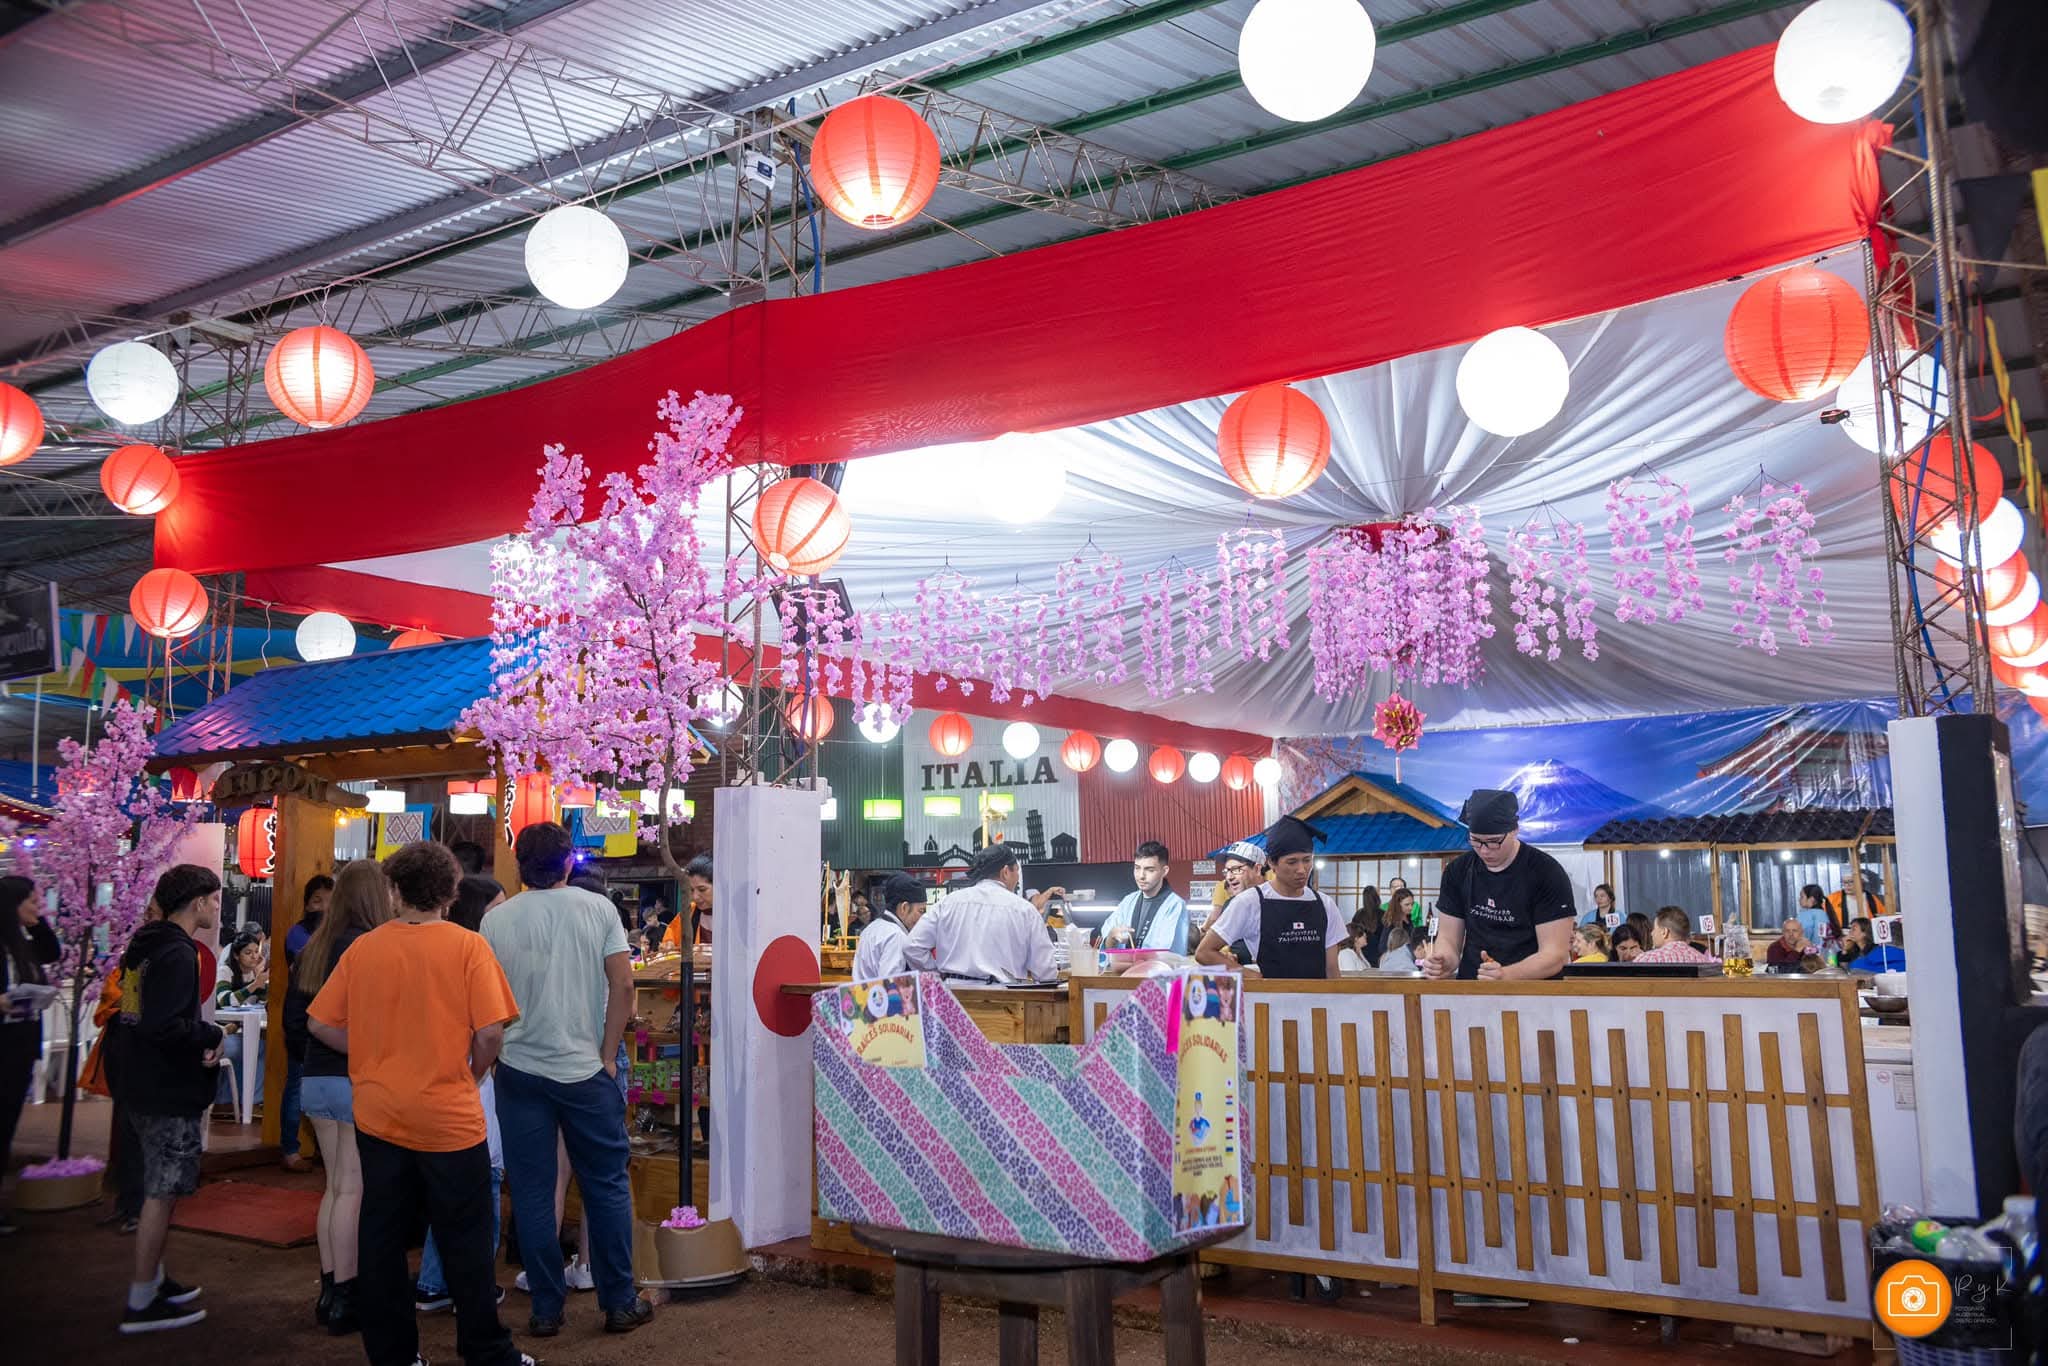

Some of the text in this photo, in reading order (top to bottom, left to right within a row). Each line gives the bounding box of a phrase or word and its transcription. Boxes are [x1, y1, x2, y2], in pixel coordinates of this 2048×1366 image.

[921, 757, 1058, 791] ITALIA
[878, 1023, 915, 1044] SOLIDARIAS
[1192, 1033, 1228, 1064] SOLIDARIAS
